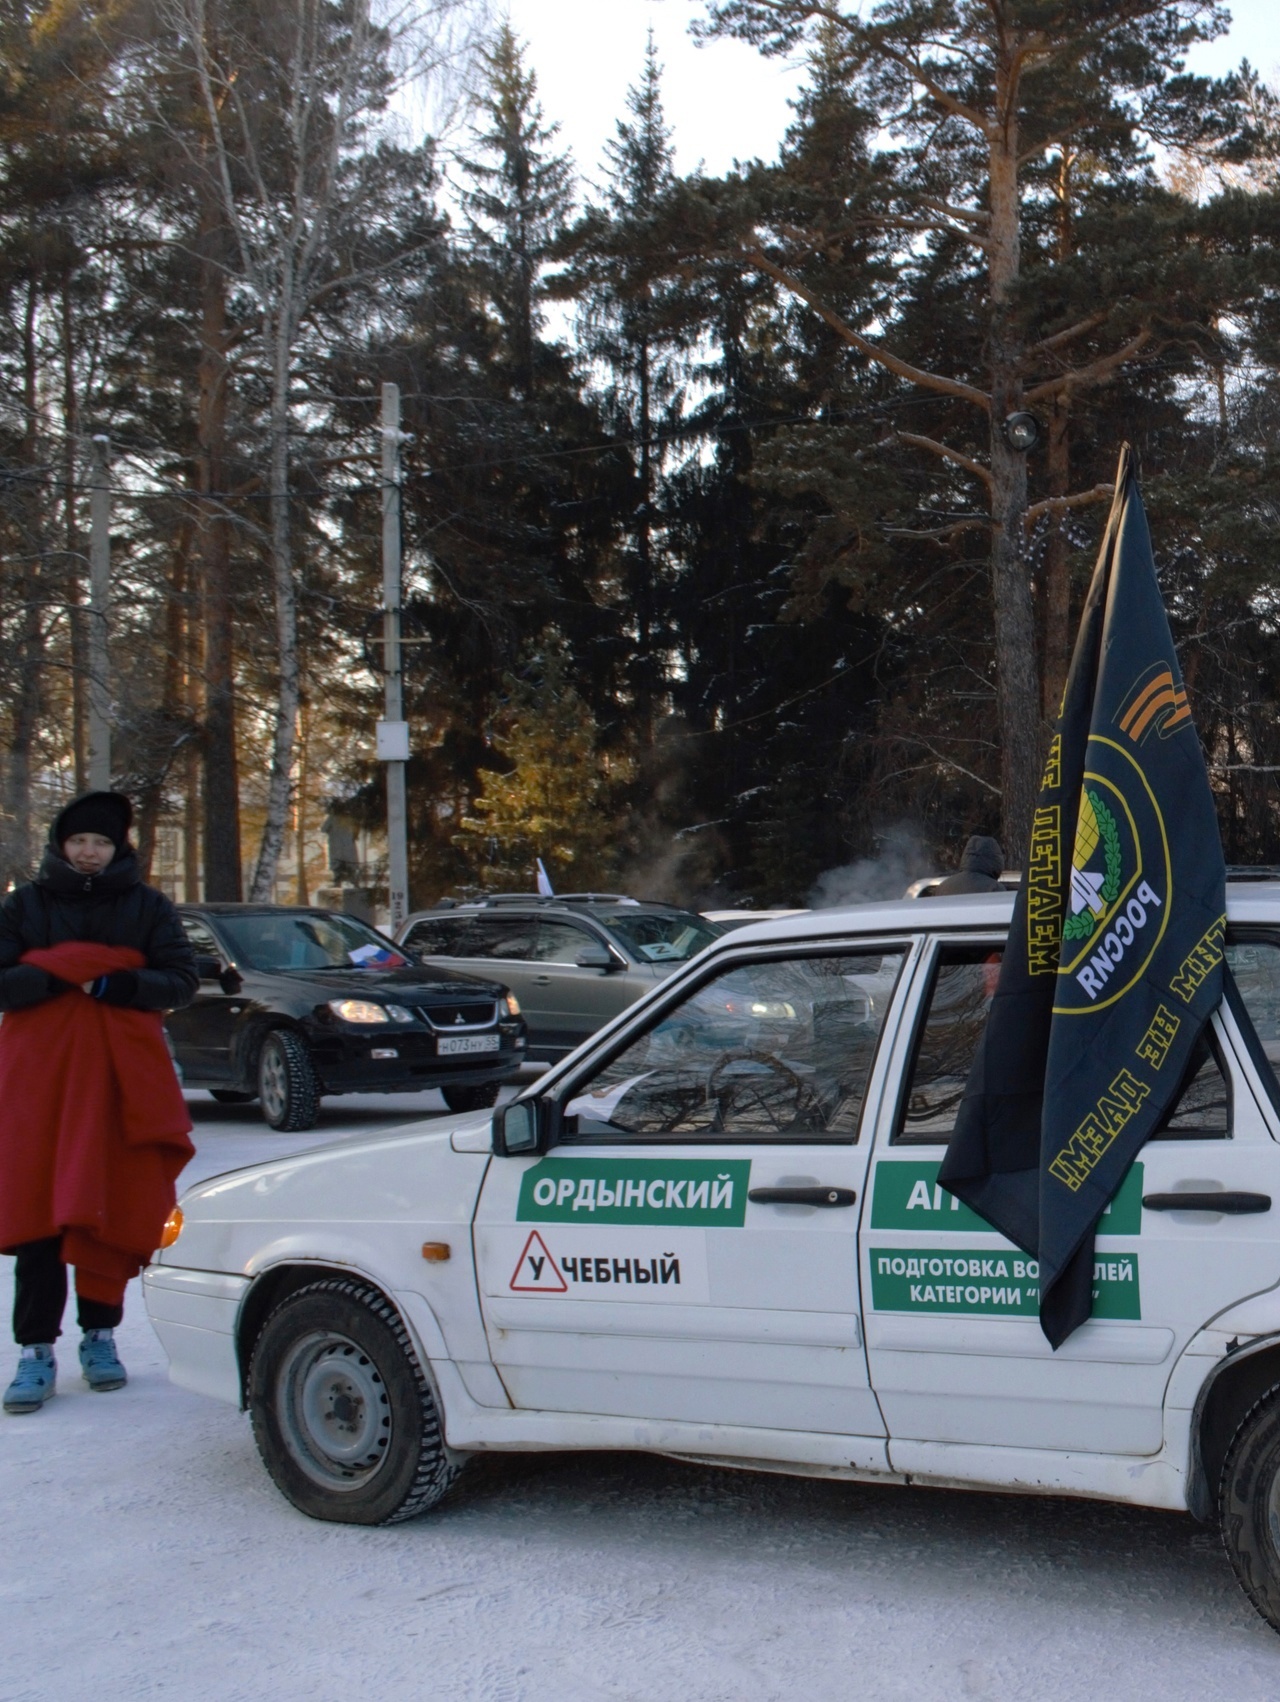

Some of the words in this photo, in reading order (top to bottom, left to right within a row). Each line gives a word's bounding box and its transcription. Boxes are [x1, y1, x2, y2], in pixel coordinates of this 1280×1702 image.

[533, 1173, 734, 1212] ОРДЫНСКИЙ
[878, 1257, 1009, 1279] ПОДГОТОВКА
[1013, 1259, 1133, 1282] ВОЛЕЙ
[910, 1285, 1022, 1305] КАТЕГОРИИ
